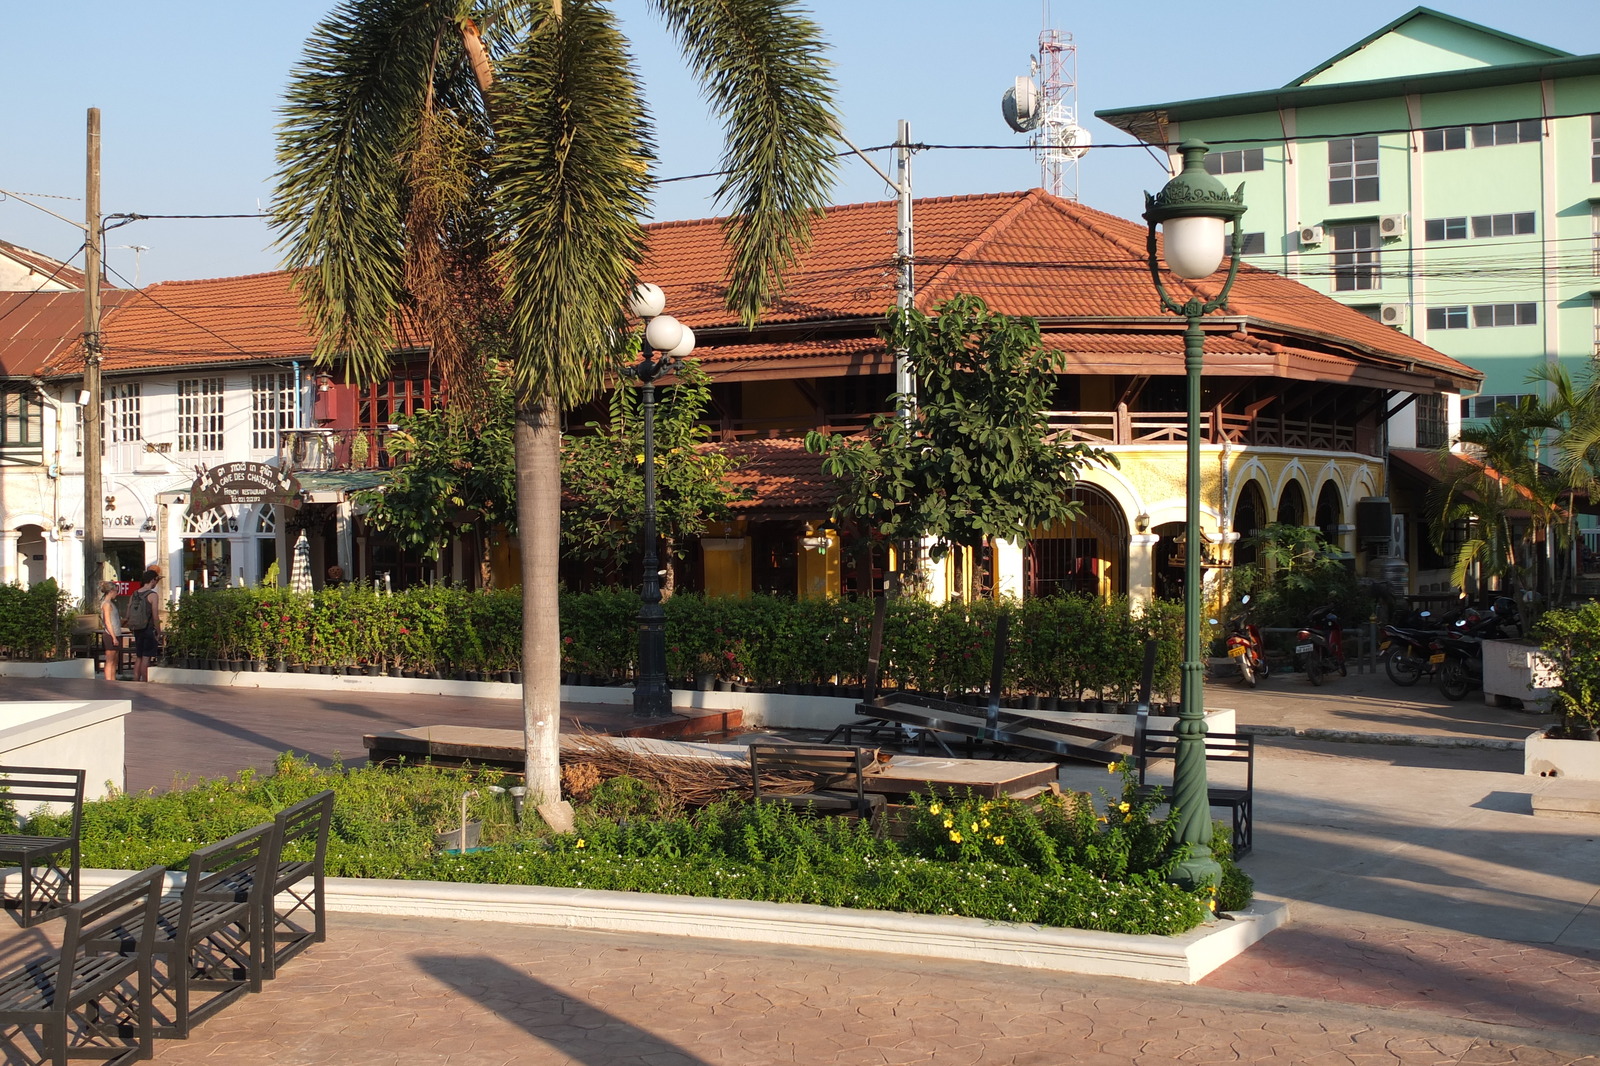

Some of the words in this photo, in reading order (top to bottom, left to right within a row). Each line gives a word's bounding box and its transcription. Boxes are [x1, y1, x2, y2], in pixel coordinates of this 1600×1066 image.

[213, 484, 222, 493] LA
[220, 474, 233, 486] CAVE
[235, 473, 245, 481] DES
[247, 473, 277, 492] CHATEAUX
[115, 515, 123, 526] of
[123, 515, 135, 526] Silk
